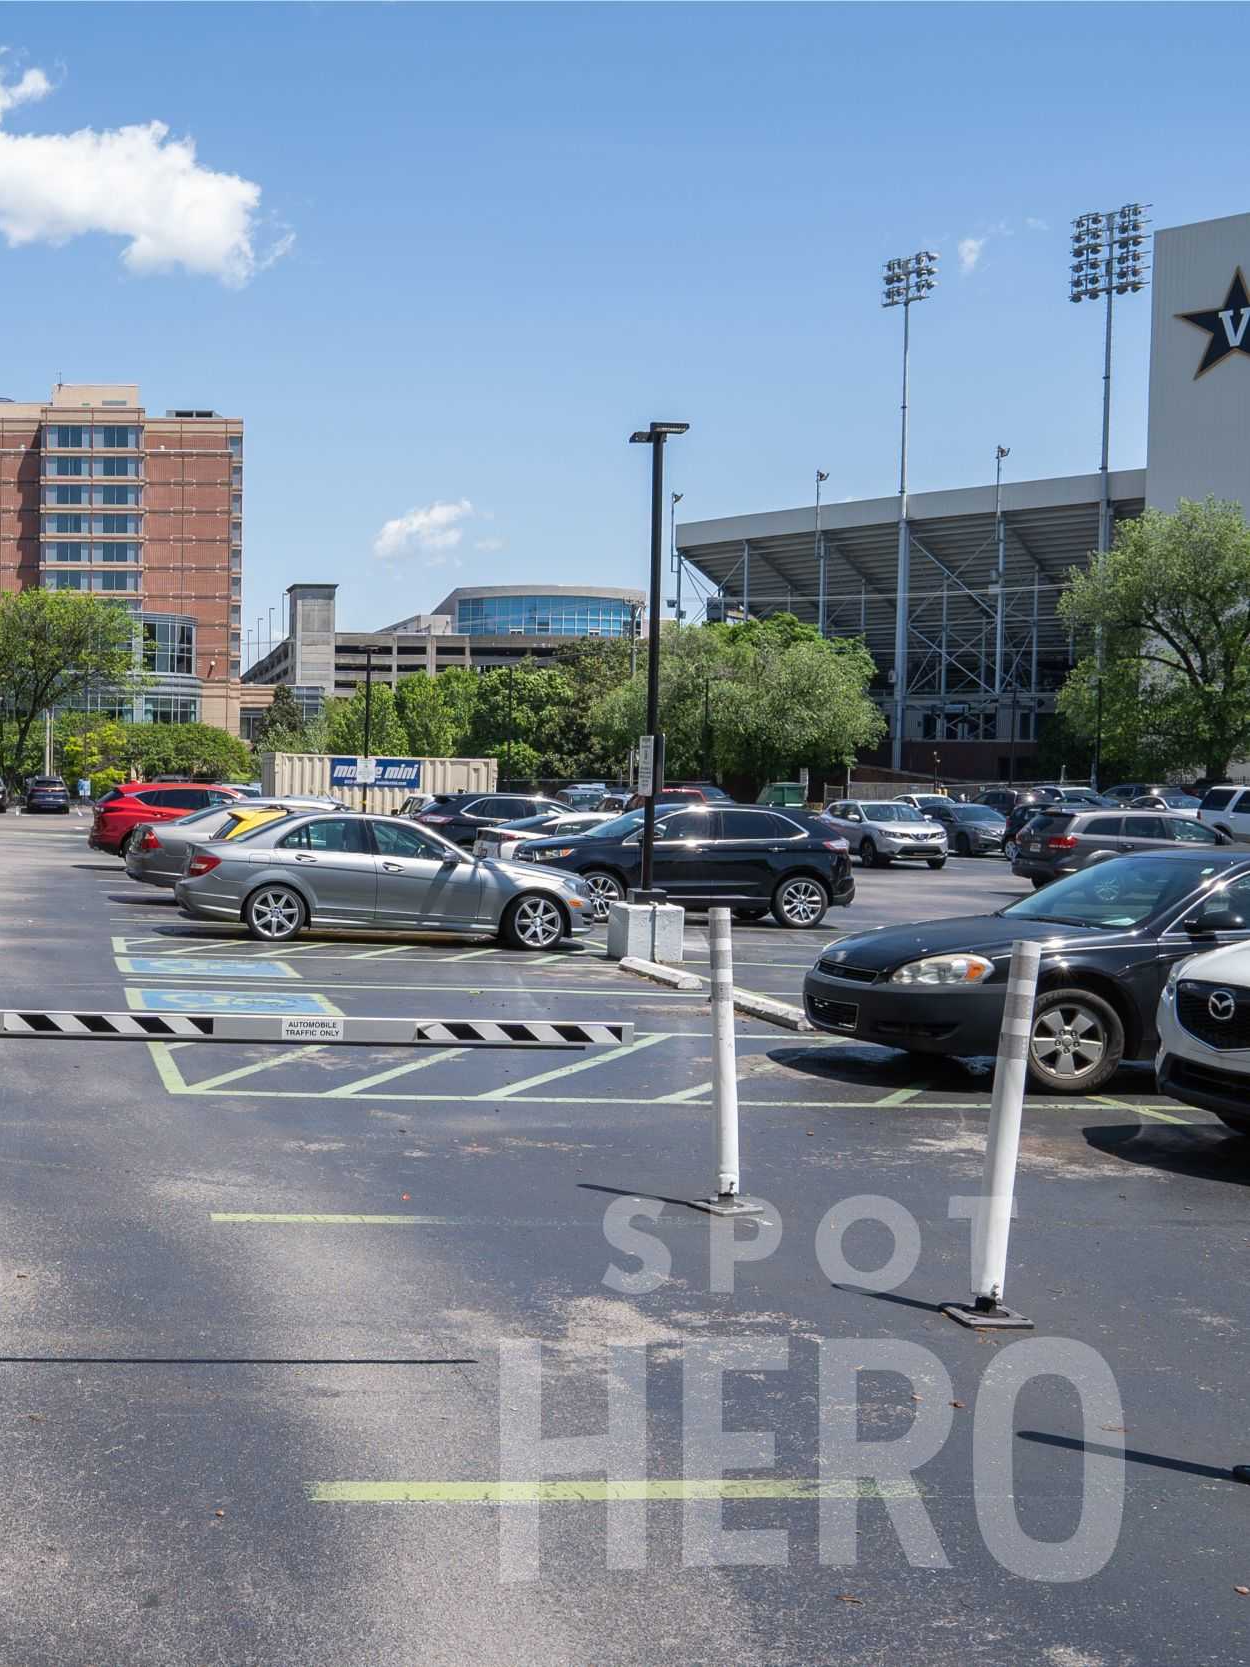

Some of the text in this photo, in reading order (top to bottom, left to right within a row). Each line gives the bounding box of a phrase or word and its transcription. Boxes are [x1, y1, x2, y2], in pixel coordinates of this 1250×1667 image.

[1218, 307, 1250, 348] V
[384, 763, 419, 779] mini
[288, 1021, 337, 1029] AUTOMOBILE
[285, 1029, 340, 1037] TRAFFIC ONLY
